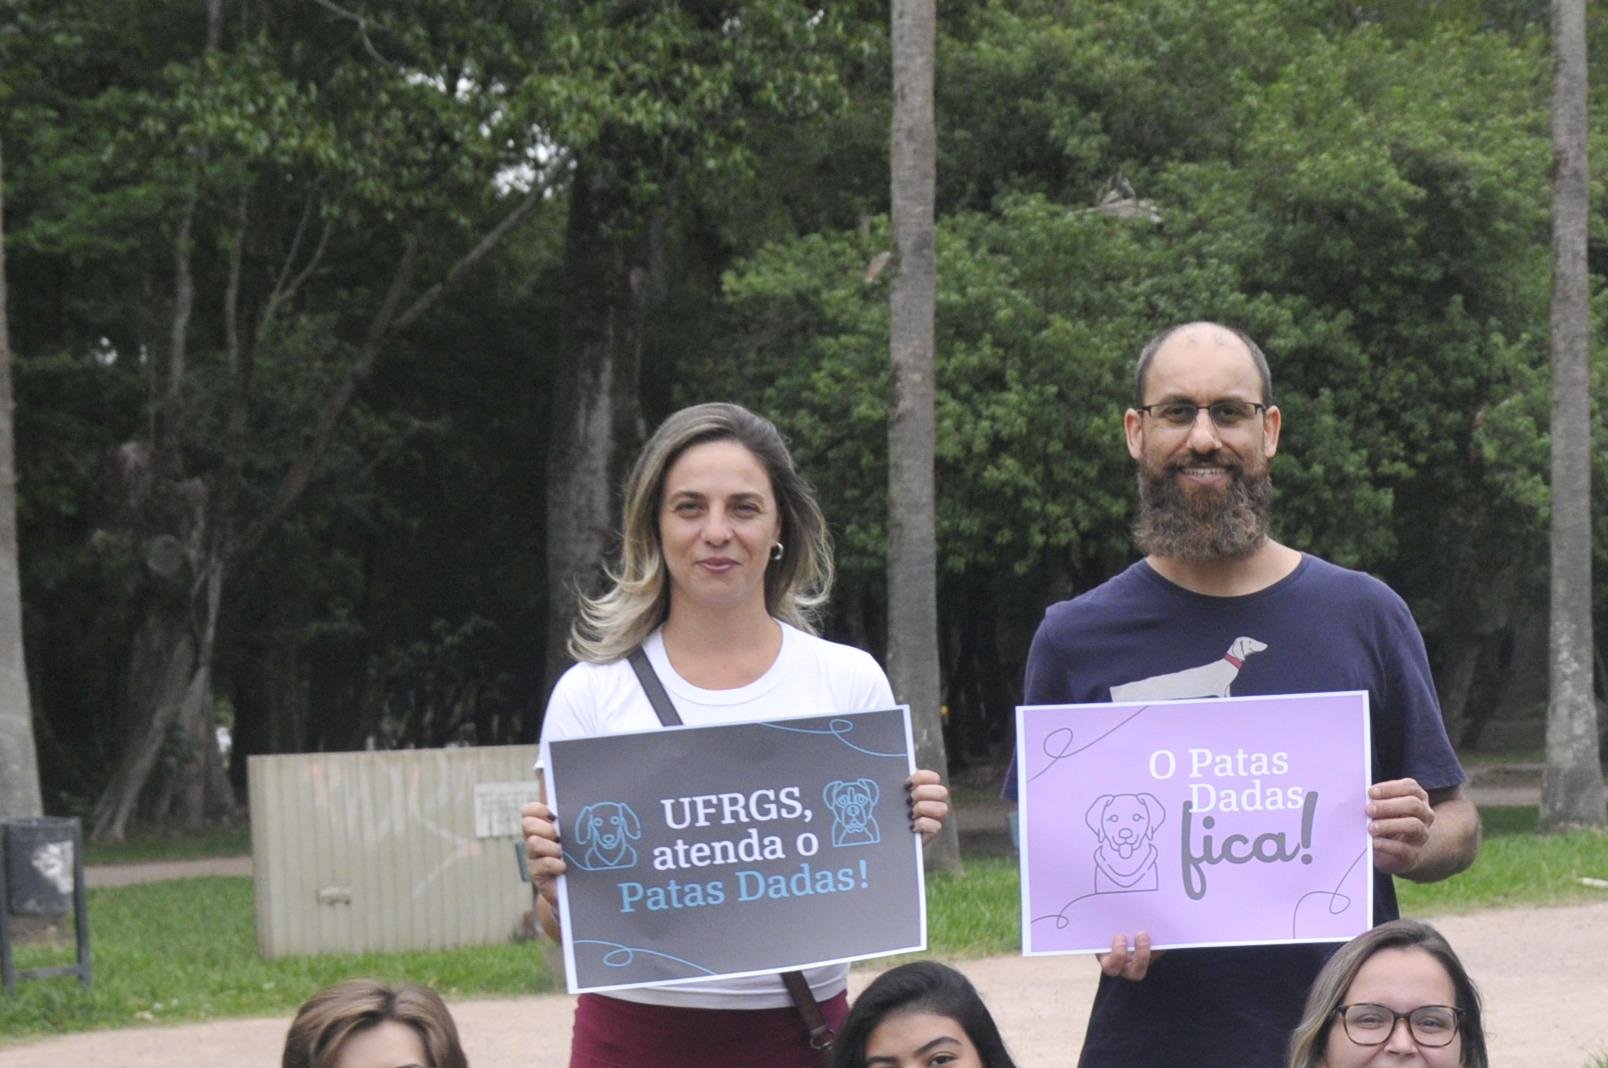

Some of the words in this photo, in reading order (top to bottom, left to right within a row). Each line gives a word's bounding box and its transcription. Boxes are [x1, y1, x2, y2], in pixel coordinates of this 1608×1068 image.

[1149, 749, 1176, 779] O
[1188, 748, 1289, 778] Patas
[660, 786, 813, 830] UFRGS,
[1188, 779, 1304, 813] Dadas
[653, 828, 786, 870] atenda
[796, 832, 819, 856] o
[1181, 791, 1319, 901] fica!
[618, 880, 725, 913] Patas
[735, 859, 868, 902] Dadas!
